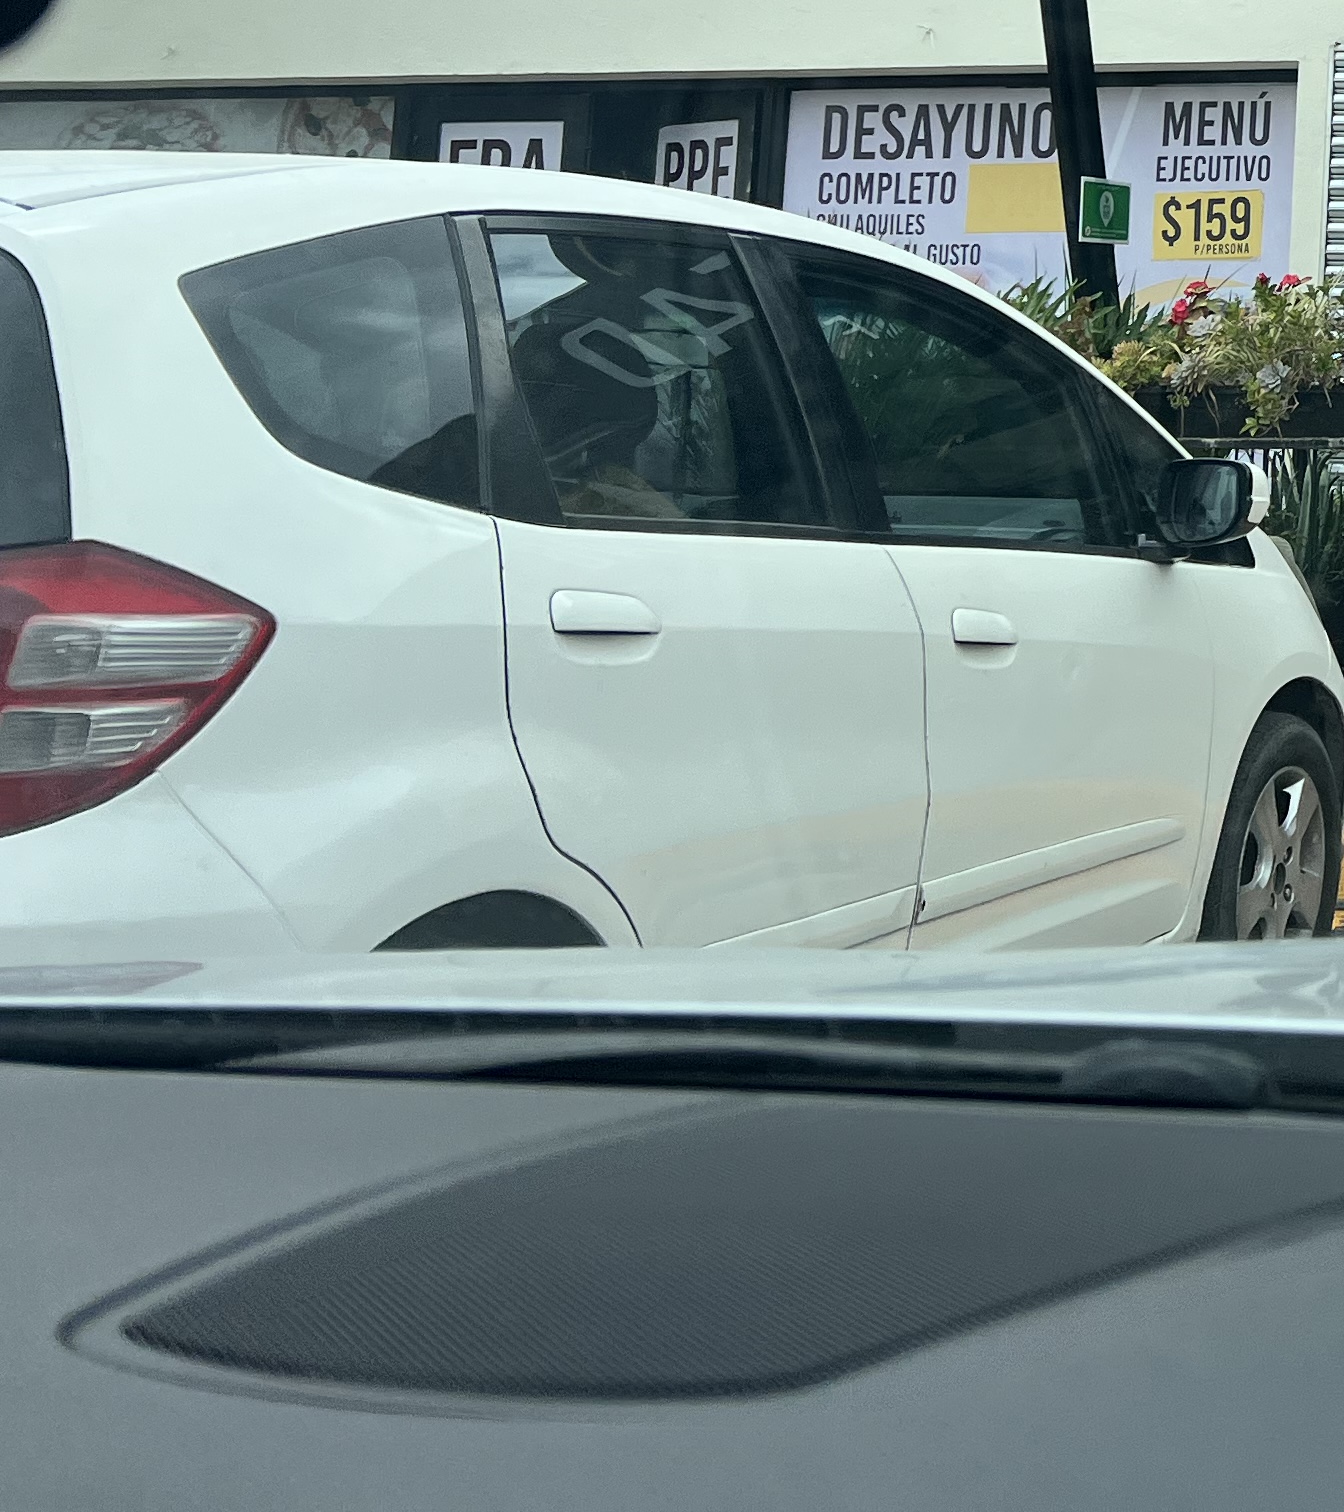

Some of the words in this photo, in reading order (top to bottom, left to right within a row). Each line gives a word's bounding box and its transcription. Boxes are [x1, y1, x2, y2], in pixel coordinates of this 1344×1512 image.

[822, 101, 1057, 161] DESAYUNO
[1162, 91, 1272, 147] MENÚ
[1156, 155, 1271, 182] EJECUTIVO
[818, 171, 957, 205] COMPLETO
[1161, 196, 1251, 247] $159
[927, 243, 982, 266] GUSTO
[1194, 243, 1250, 255] P/PERSONA
